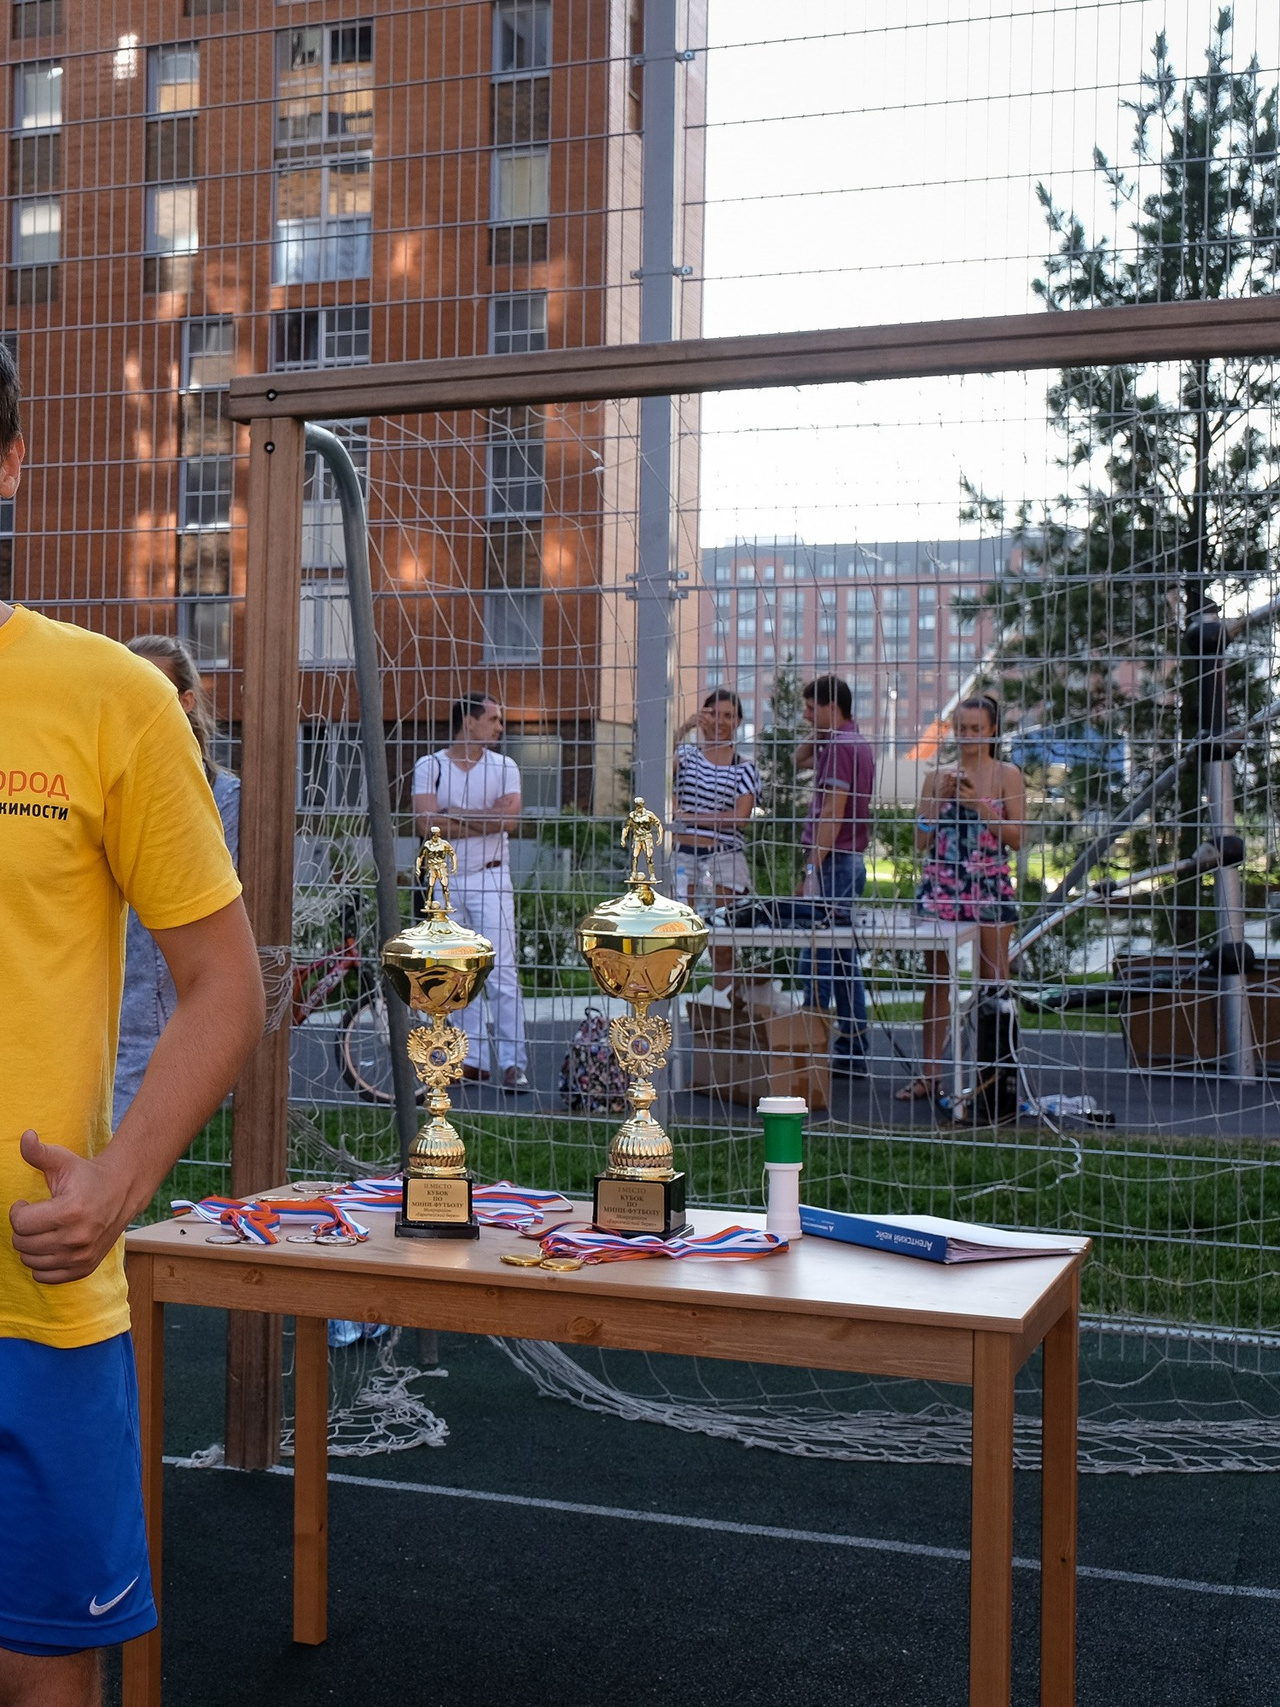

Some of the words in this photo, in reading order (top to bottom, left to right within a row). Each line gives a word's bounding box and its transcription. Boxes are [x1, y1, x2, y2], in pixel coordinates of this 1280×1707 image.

[620, 1194, 644, 1202] КУБОК
[603, 1206, 660, 1216] МИНИ-ФУТБОЛУ
[893, 1234, 933, 1251] Агентский
